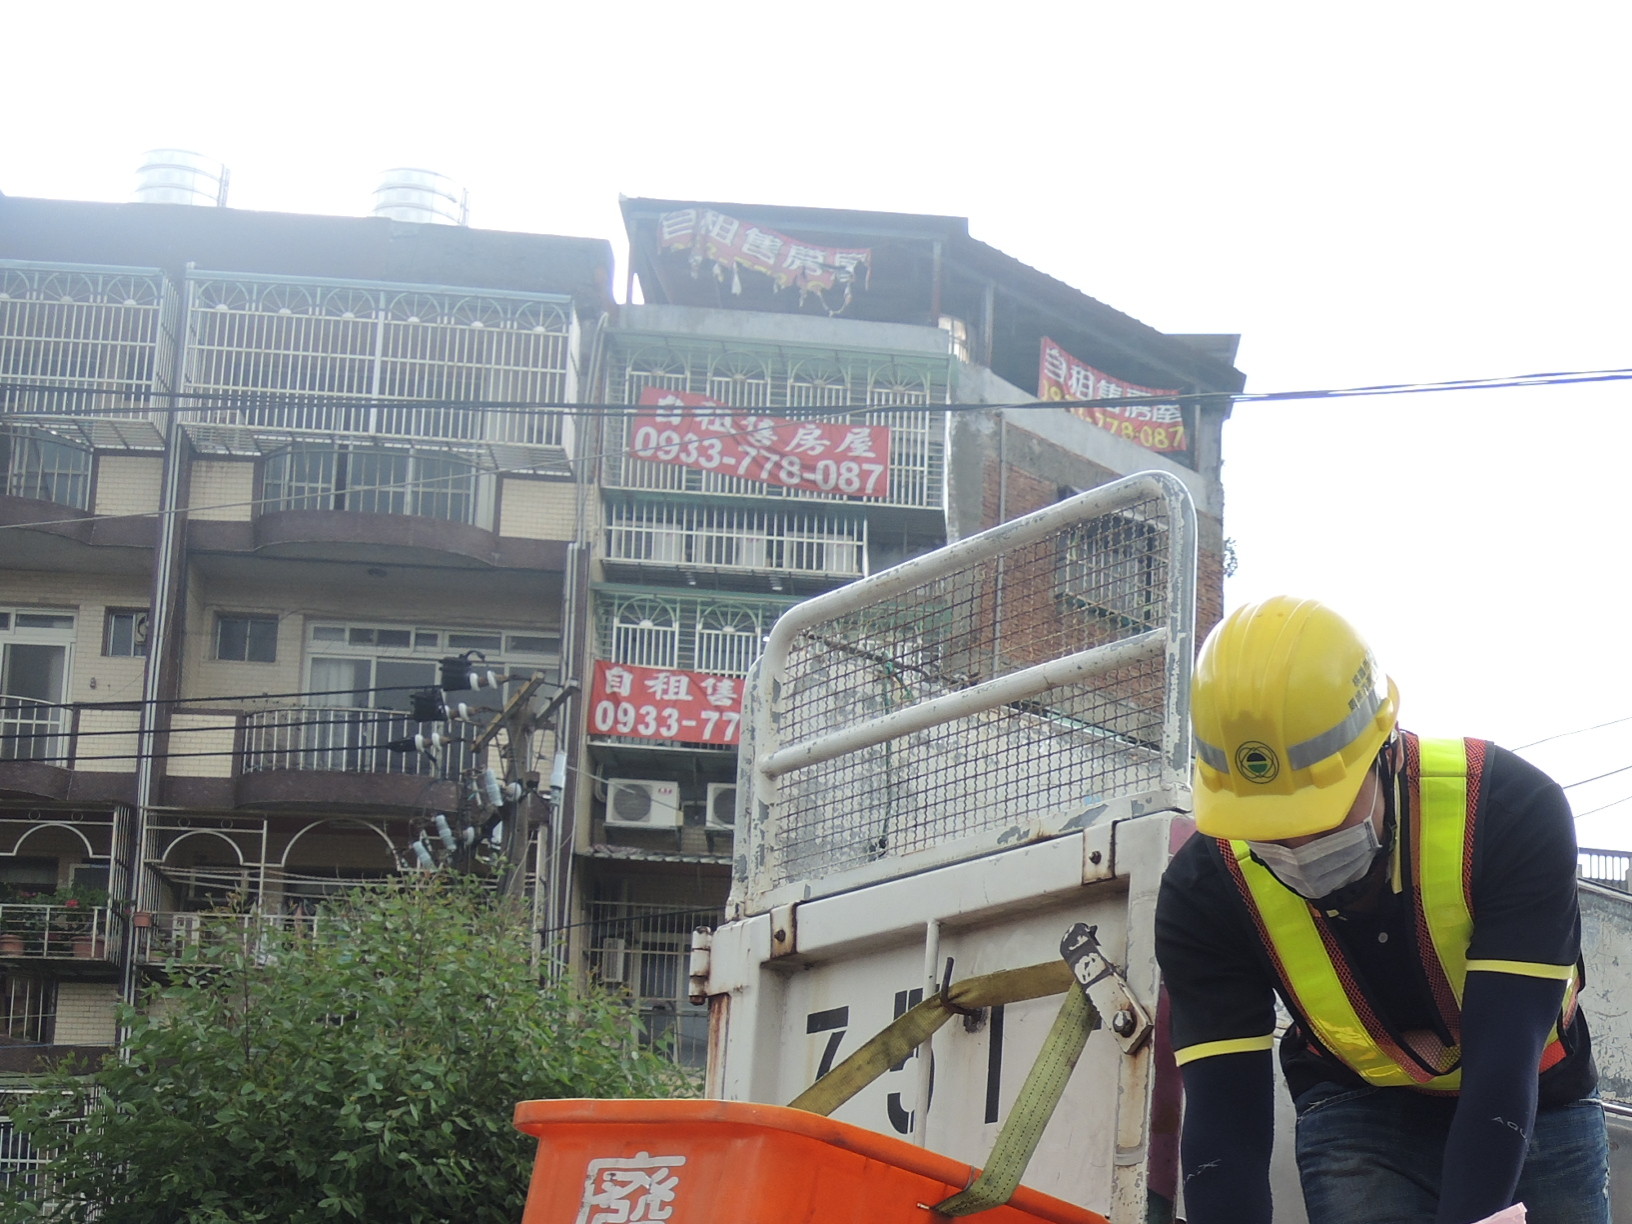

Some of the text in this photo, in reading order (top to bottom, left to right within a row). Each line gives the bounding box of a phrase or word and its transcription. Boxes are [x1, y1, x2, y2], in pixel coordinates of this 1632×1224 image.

[655, 394, 877, 458] 自租售房屋
[634, 426, 885, 494] 0933-778-087
[605, 666, 738, 706] 自租售
